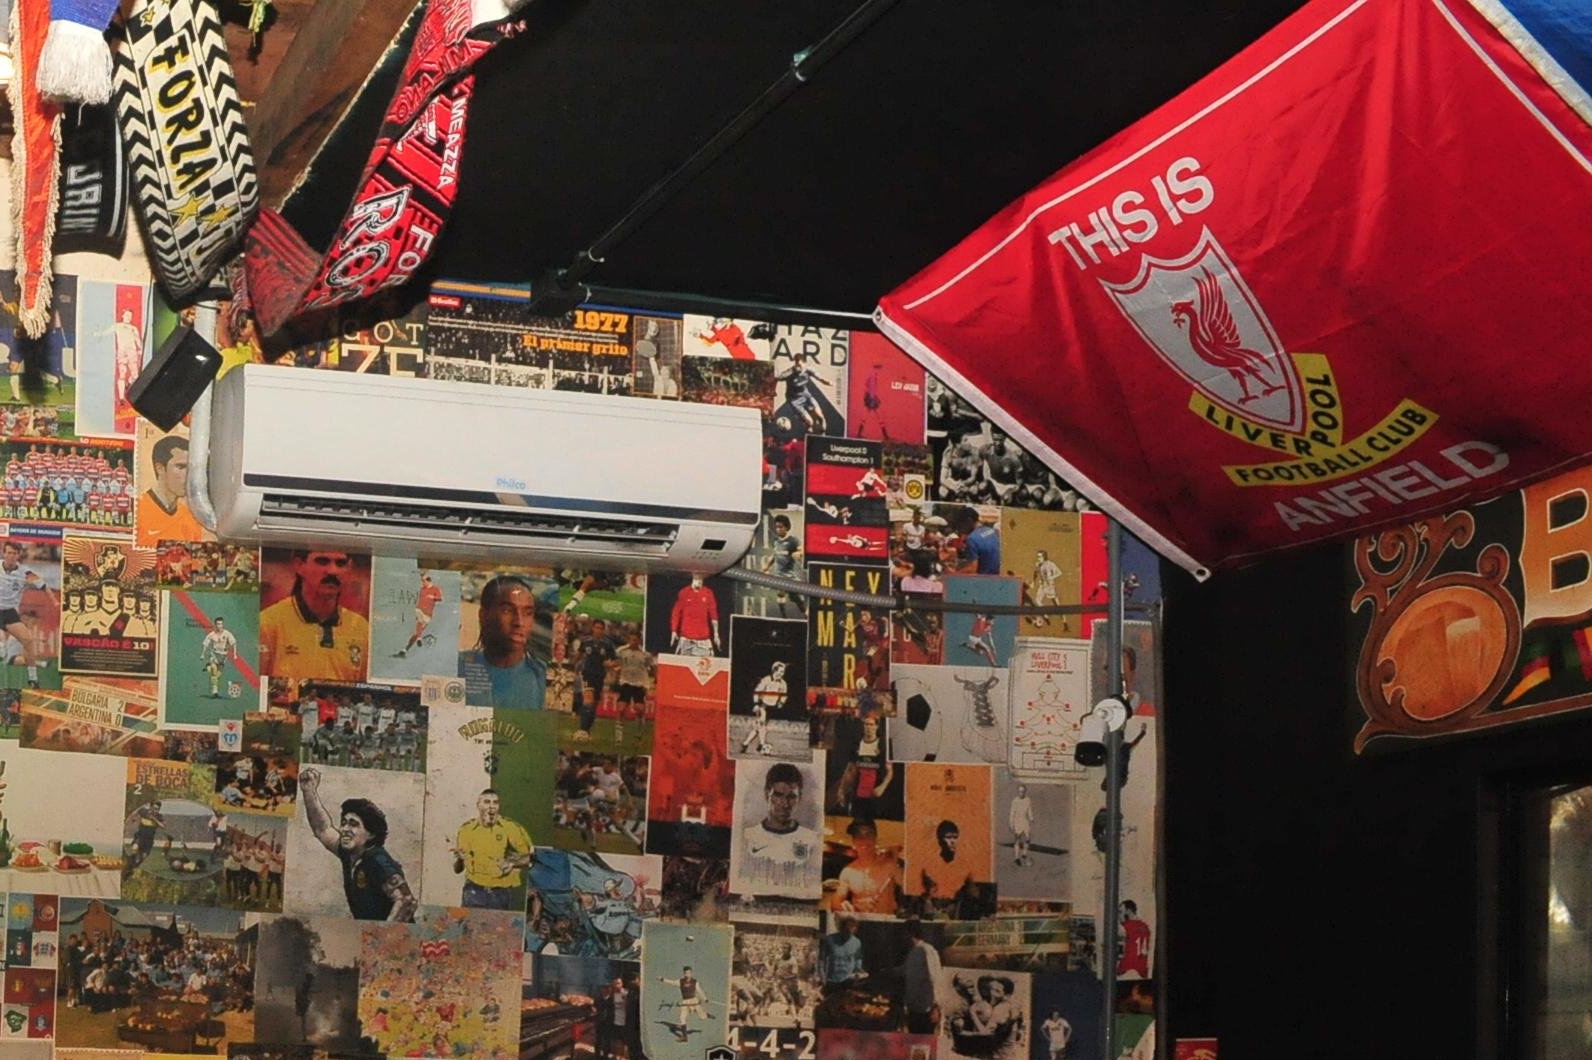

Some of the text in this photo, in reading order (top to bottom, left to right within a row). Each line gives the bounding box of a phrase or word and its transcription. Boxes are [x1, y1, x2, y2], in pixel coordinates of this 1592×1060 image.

[152, 37, 217, 196] FORZA
[437, 97, 467, 190] MEAZZA
[1048, 156, 1215, 270] THIS IS
[573, 310, 629, 333] 1977
[522, 333, 629, 358] El primer grito
[772, 340, 848, 367] ARD
[1205, 373, 1340, 459] LIVERPOOL
[830, 443, 861, 456] Liverpool
[1235, 407, 1428, 484] FOOTBALL CLUB
[821, 452, 868, 465] Southampton
[1273, 440, 1511, 531] ANFIELD
[68, 701, 113, 722] ARGENTINA
[71, 688, 124, 713] BULGARIA 2
[135, 764, 191, 781] ESTRELLAS
[132, 784, 143, 795] 2
